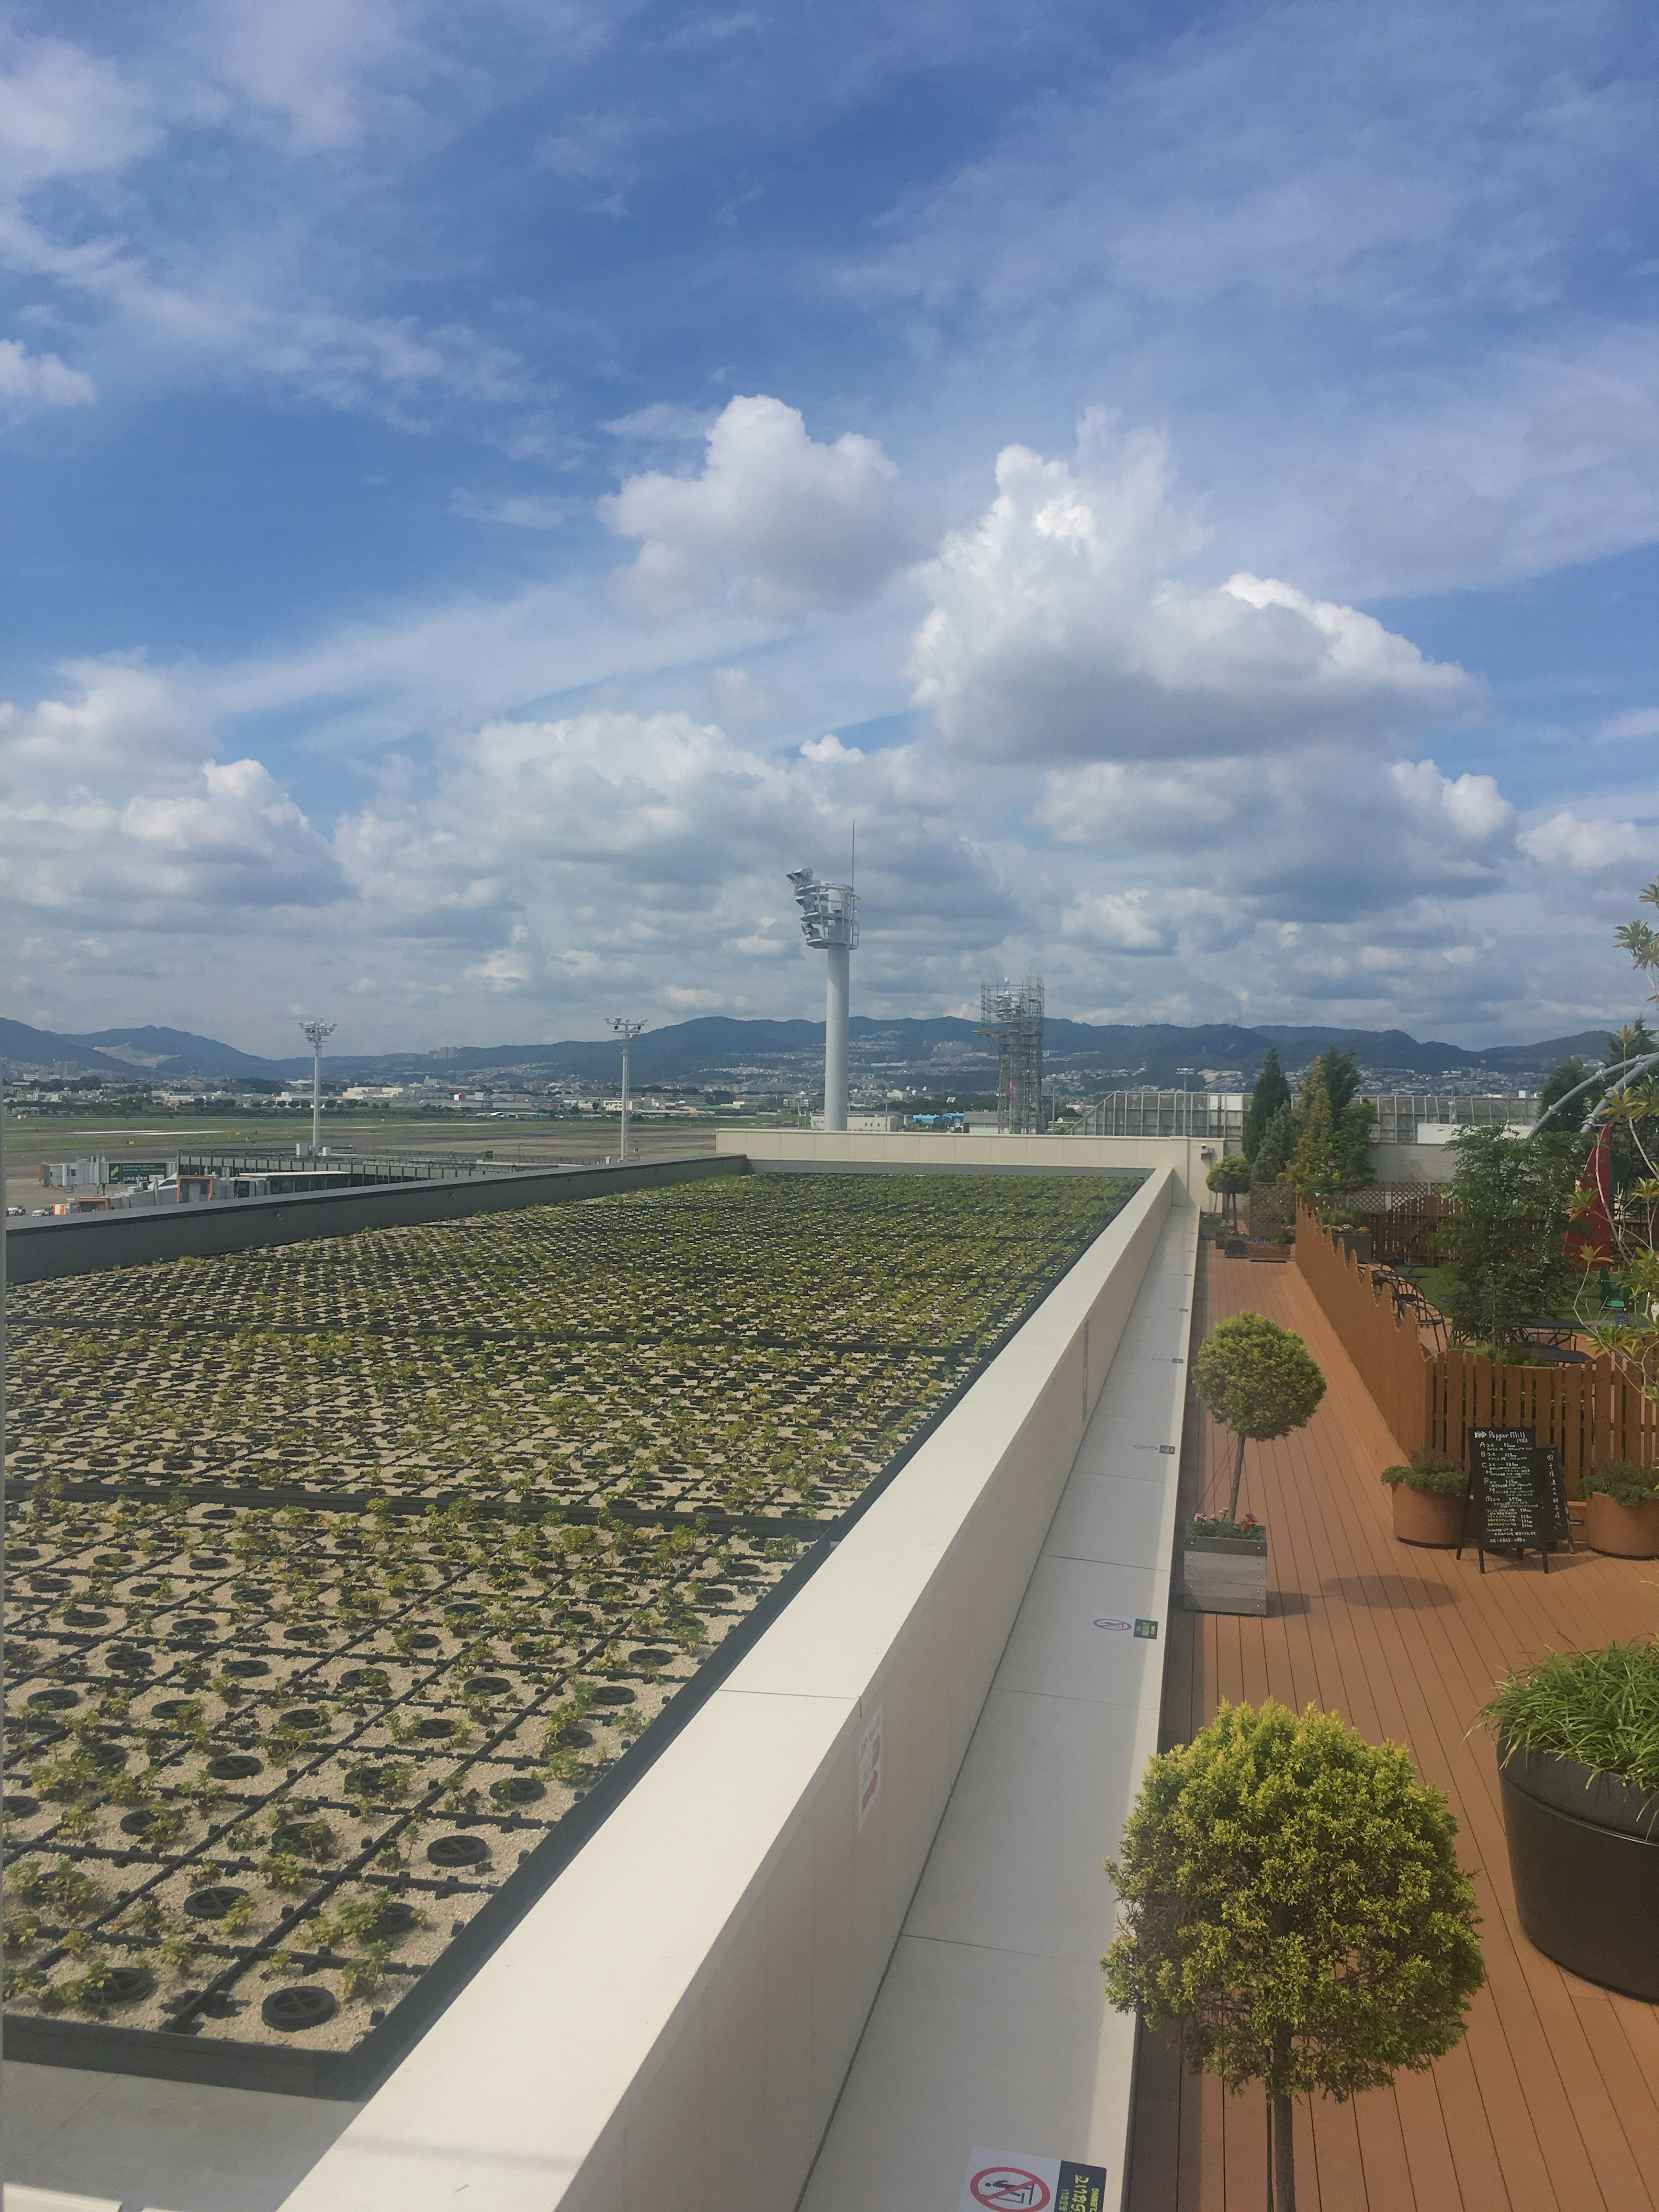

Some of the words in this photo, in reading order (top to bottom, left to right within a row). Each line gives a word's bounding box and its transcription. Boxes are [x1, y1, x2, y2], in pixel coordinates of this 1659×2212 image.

[1488, 1431, 1509, 1441] Pepper
[1059, 2189, 1069, 2212] あぶない
[1070, 2174, 1089, 2212] らないで
